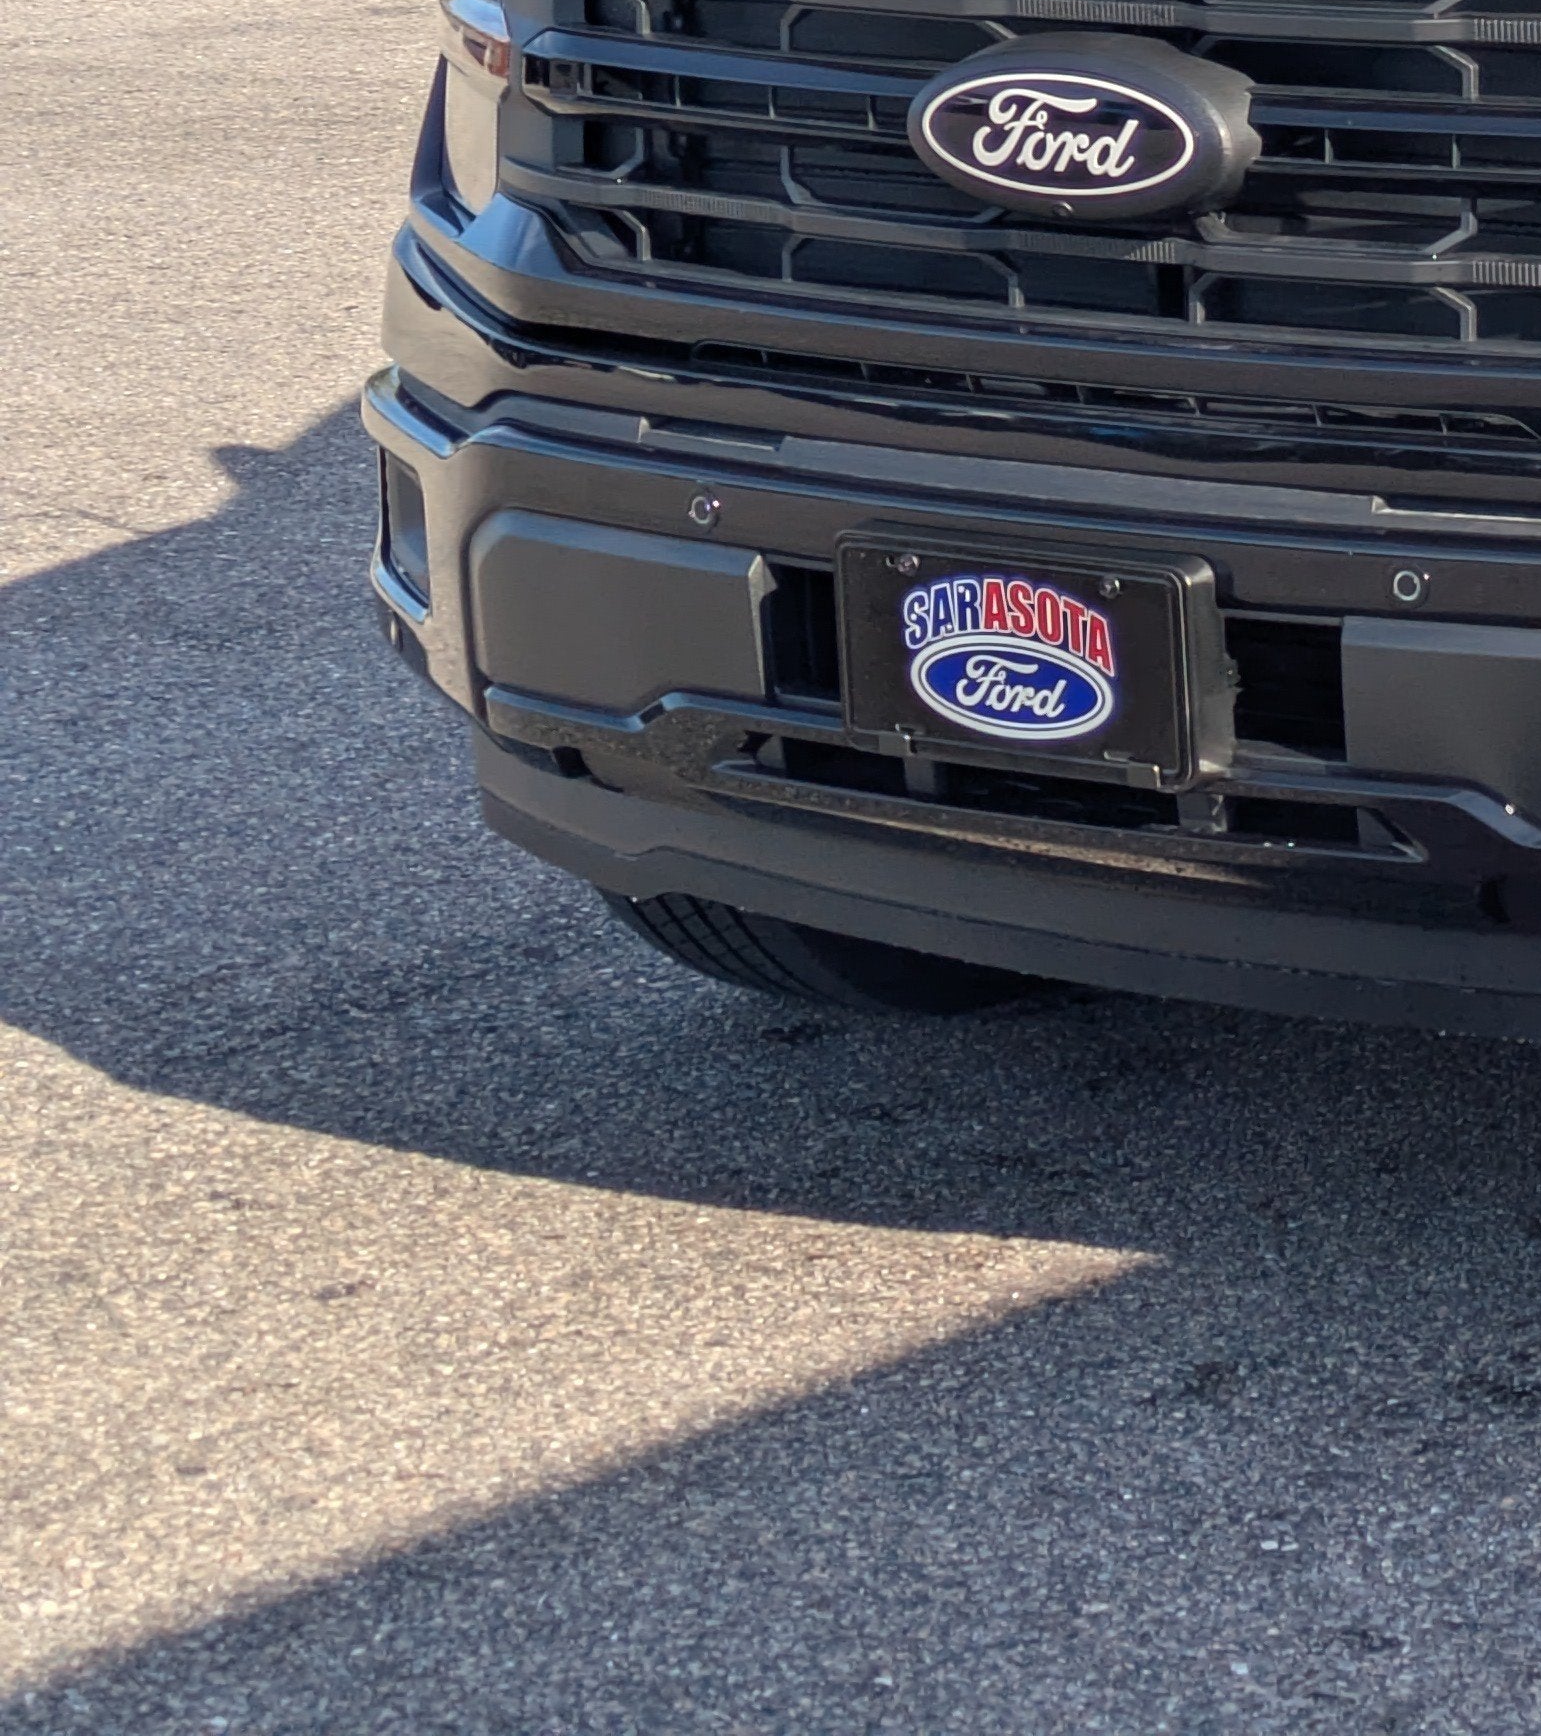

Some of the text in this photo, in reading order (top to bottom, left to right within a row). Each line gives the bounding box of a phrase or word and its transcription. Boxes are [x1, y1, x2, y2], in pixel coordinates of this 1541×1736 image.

[972, 88, 1139, 177] Ford
[903, 578, 1115, 677] SARASOTA
[955, 654, 1068, 719] Ford
